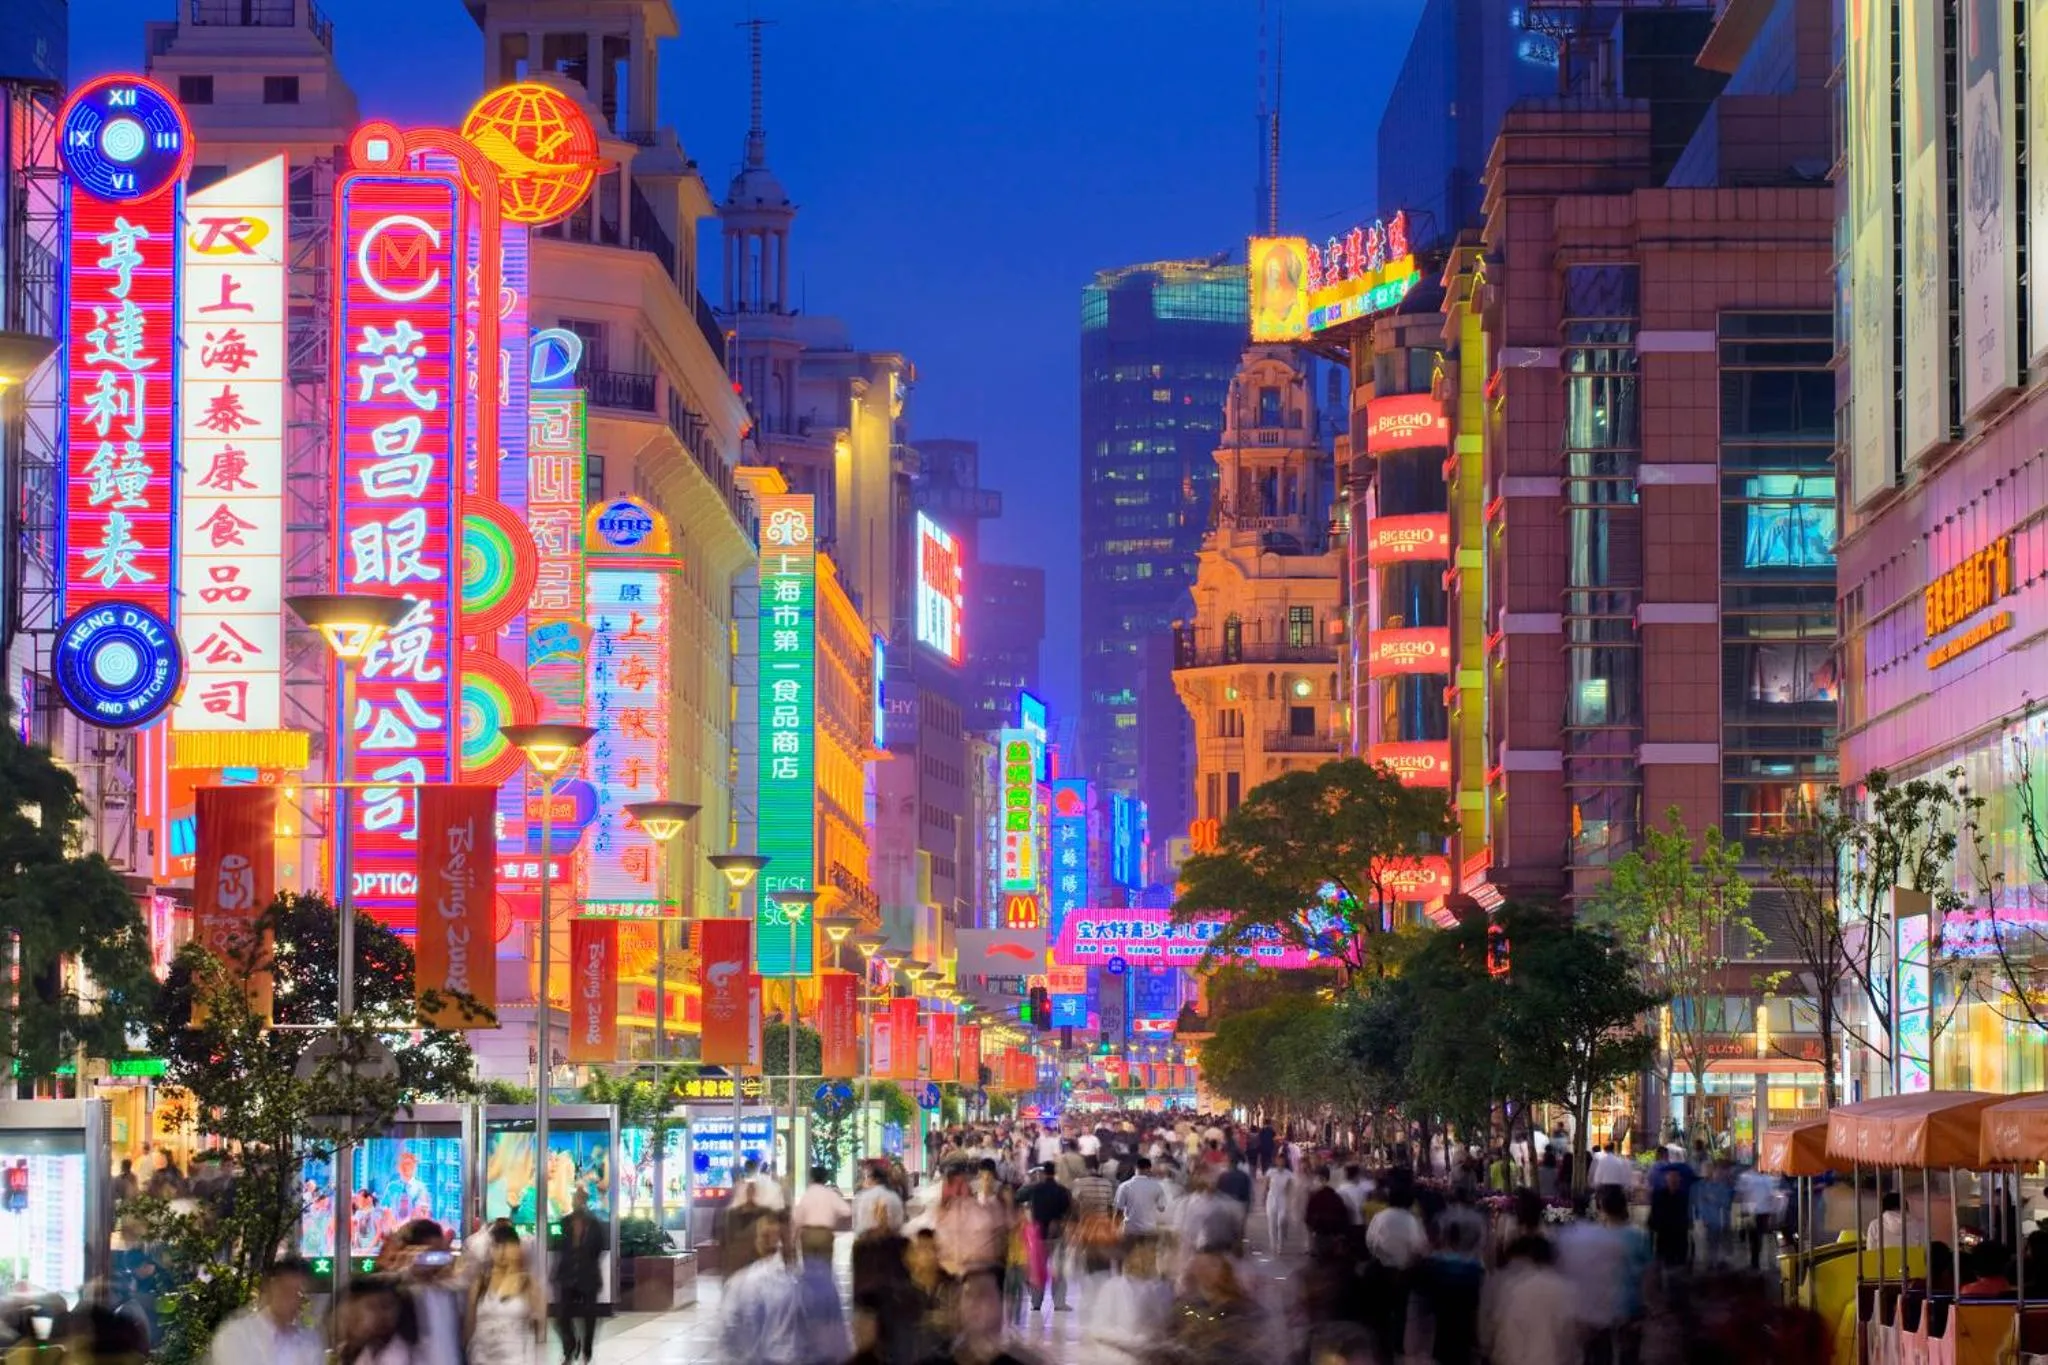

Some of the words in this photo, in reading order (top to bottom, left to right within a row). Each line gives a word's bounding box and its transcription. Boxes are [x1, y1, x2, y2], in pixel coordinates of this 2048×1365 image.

[109, 89, 136, 106] XII
[69, 130, 92, 147] IX
[157, 132, 178, 149] III
[111, 173, 135, 190] VI
[192, 273, 263, 722] 上海泰康食品公司
[68, 611, 116, 650] HENG
[123, 611, 165, 647] DALI
[771, 554, 802, 780] 上海市第一食品商店
[96, 702, 124, 714] AND
[128, 658, 169, 711] WATCHES
[438, 816, 474, 920] Beijing
[1708, 1045, 1743, 1055] ELATO
